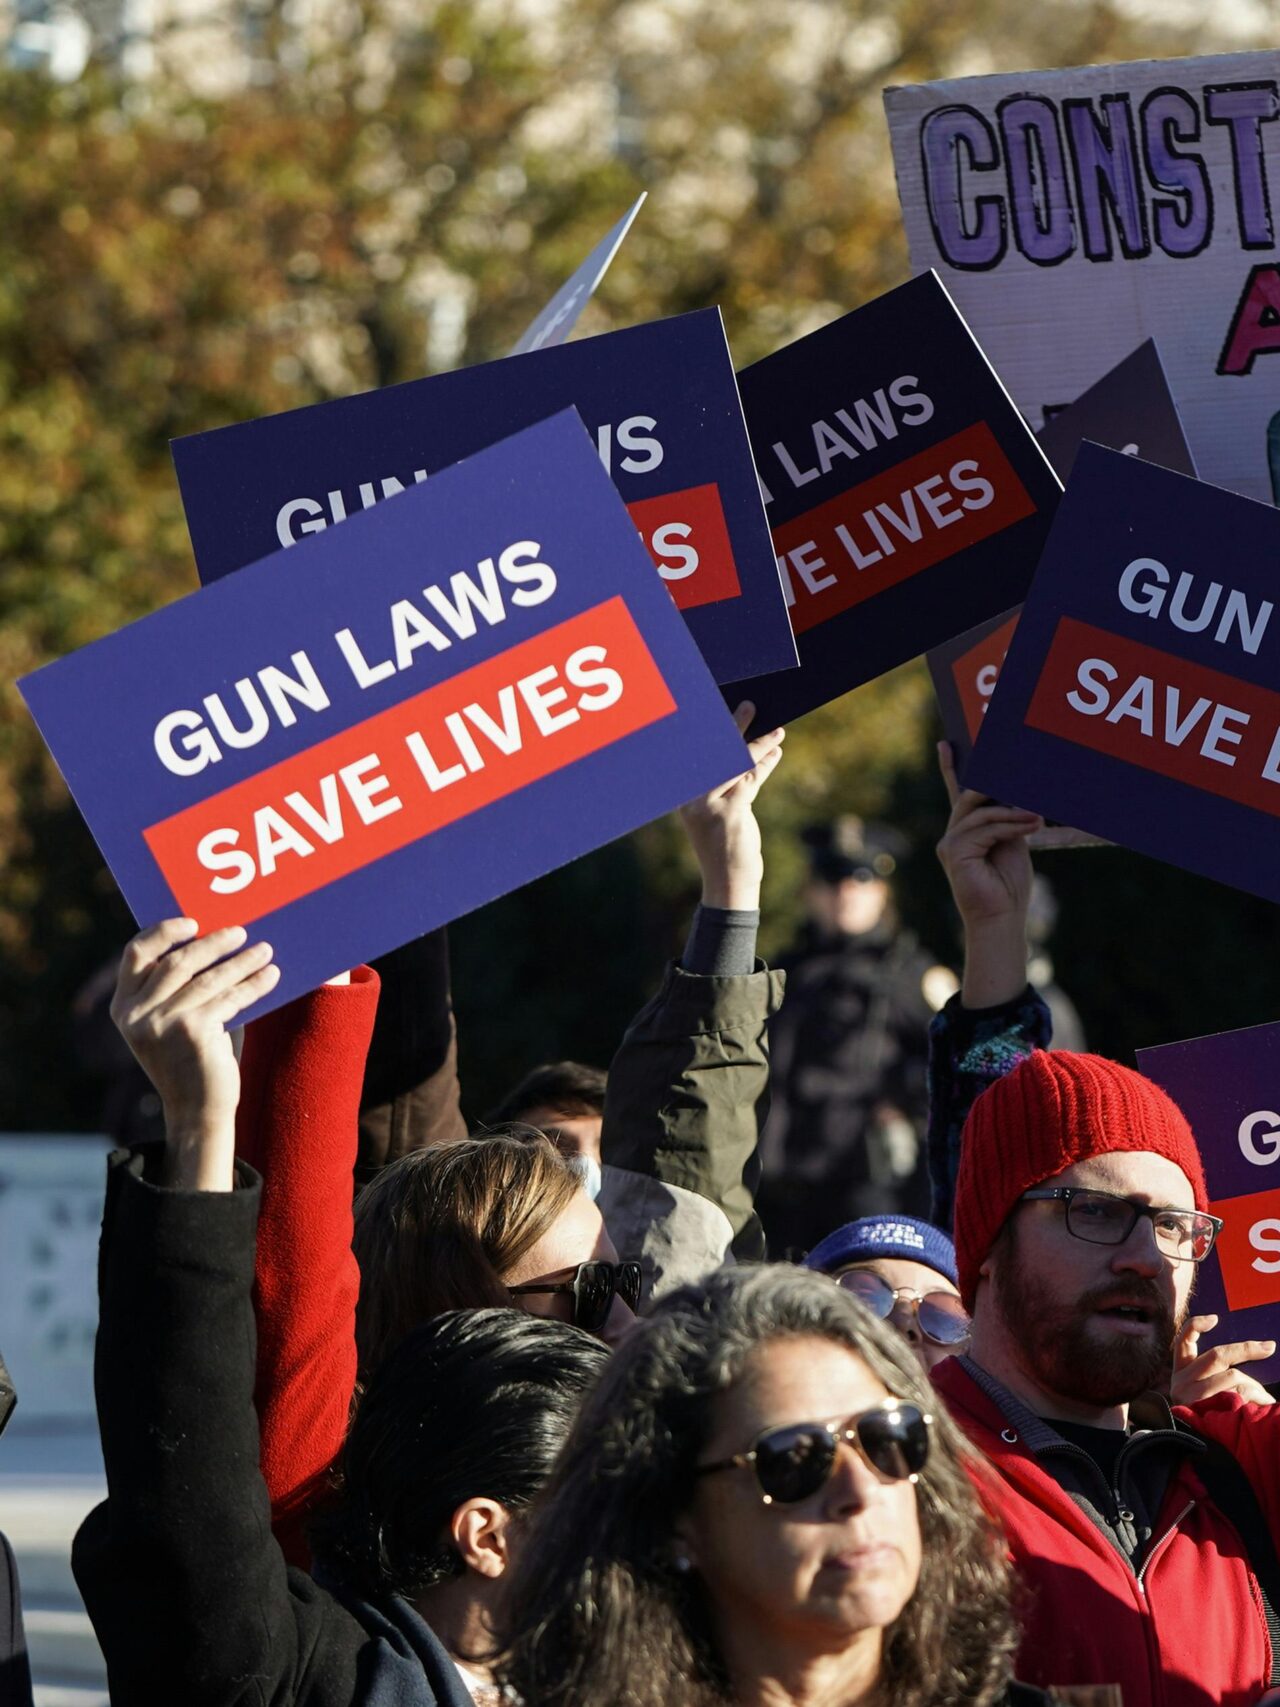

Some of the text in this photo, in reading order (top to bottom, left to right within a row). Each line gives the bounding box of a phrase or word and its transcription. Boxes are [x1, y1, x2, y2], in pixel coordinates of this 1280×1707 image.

[772, 375, 935, 488] LAWS
[834, 459, 995, 570] LIVES
[153, 650, 331, 777] GUN
[335, 540, 558, 689] LAWS
[1118, 557, 1274, 656] GUN
[1065, 658, 1253, 767] SAVE
[195, 645, 624, 894] SAVE LIVES
